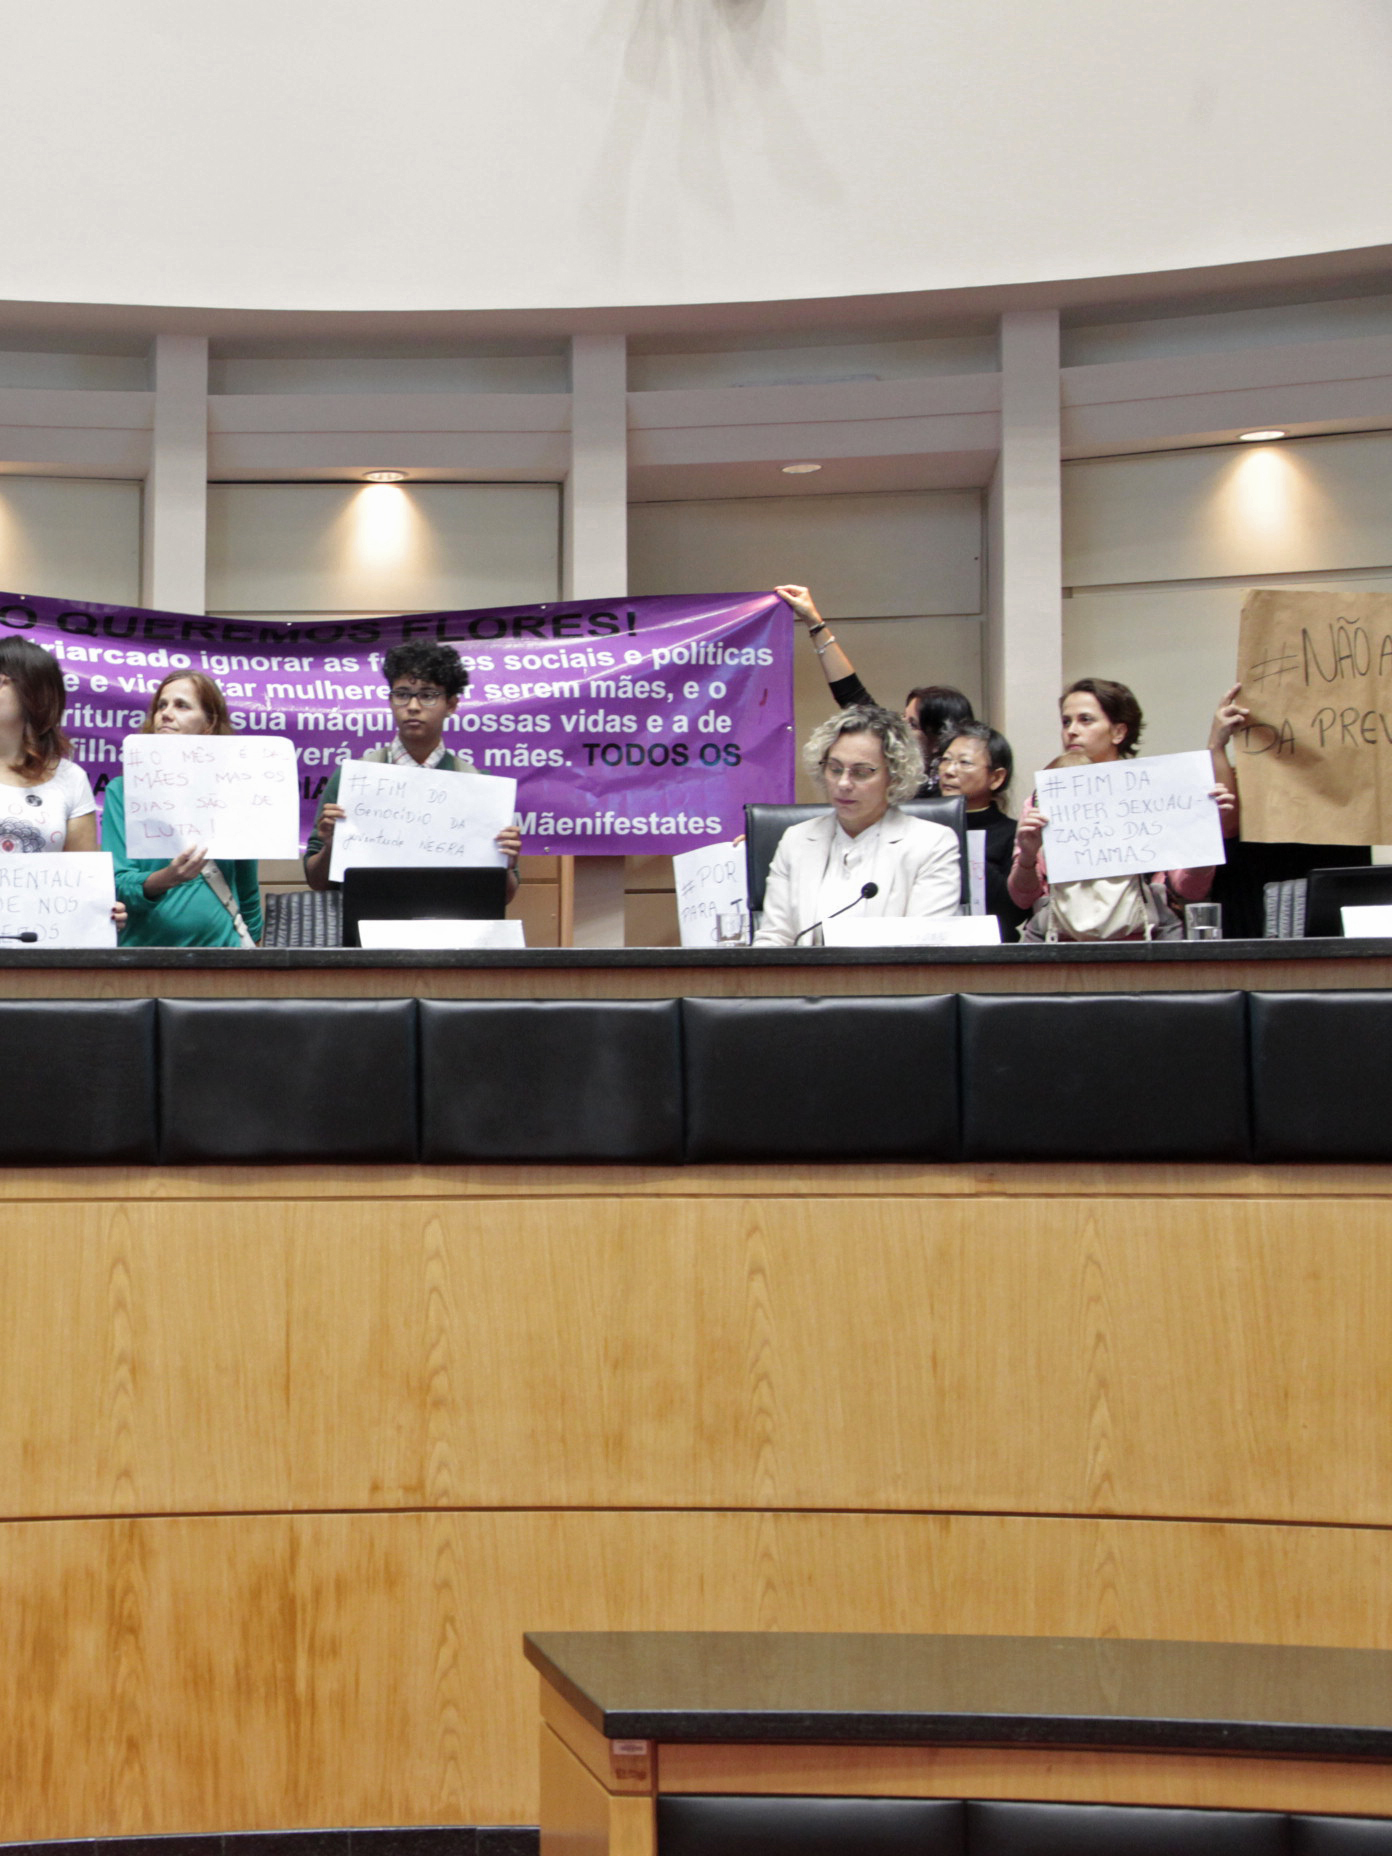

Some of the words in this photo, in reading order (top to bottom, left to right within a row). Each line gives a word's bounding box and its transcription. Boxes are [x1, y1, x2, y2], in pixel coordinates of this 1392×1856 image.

[57, 611, 380, 645] QUEREMOS
[401, 611, 638, 643] FLORES!
[201, 651, 314, 675] ignorar
[323, 656, 360, 672] as
[504, 648, 615, 670] sociais
[624, 649, 643, 665] e
[651, 641, 773, 670] políticas
[1250, 616, 1371, 693] #NÃO
[90, 675, 109, 692] e
[484, 681, 580, 699] serem
[590, 675, 674, 702] mães,
[683, 680, 700, 699] e
[709, 680, 727, 699] o
[229, 710, 286, 731] sua
[442, 713, 551, 733] nossas
[560, 709, 637, 733] vidas
[646, 714, 663, 733] e
[672, 714, 689, 733] a
[698, 709, 732, 733] de
[1240, 718, 1296, 756] DA
[182, 746, 216, 764] MÊS
[484, 743, 572, 767] mães.
[583, 743, 689, 767] TODOS
[699, 743, 742, 767] OS
[133, 769, 190, 789] MÃES
[215, 771, 253, 784] MAS
[263, 770, 286, 783] OS
[1042, 774, 1113, 798] #FIM
[1124, 770, 1151, 791] DA
[130, 801, 176, 814] DIAS
[195, 793, 228, 809] SÃO
[251, 794, 273, 807] DE
[426, 788, 448, 804] DO
[449, 816, 466, 830] DA
[1049, 801, 1108, 825] HIPER
[1122, 821, 1163, 840] DAS
[1074, 845, 1157, 867] MAMAS
[38, 895, 79, 915] NOS
